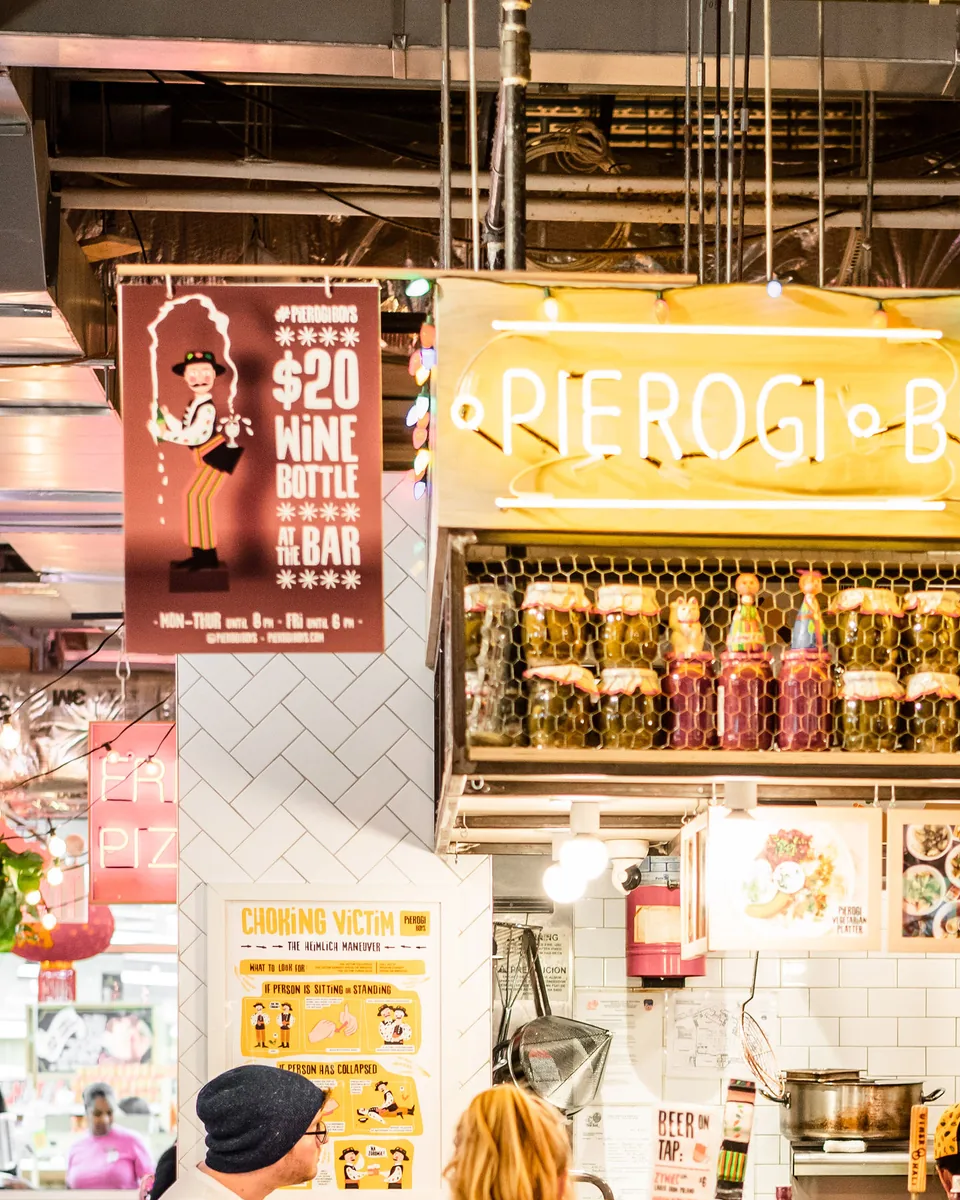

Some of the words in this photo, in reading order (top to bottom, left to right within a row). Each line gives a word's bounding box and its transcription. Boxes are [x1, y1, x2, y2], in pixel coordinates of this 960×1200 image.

[272, 348, 360, 411] $20
[502, 367, 825, 463] PIEROGI
[276, 464, 359, 500] BOTTLE
[276, 547, 300, 567] THE
[302, 525, 360, 566] BAR
[278, 527, 295, 548] AT
[288, 941, 300, 951] THE
[342, 941, 381, 952] MANEUVER
[249, 963, 265, 972] WHAT
[267, 963, 275, 972] TO
[278, 963, 293, 972] LOOK
[264, 983, 271, 994] IF
[273, 984, 300, 995] PERSON
[303, 984, 311, 994] IS
[287, 1064, 317, 1075] PERSON
[319, 1064, 335, 1075] HAS
[337, 1064, 378, 1075] COLLAPSED
[658, 1109, 694, 1139] BEER
[698, 1114, 710, 1130] ON
[658, 1139, 683, 1162] TAP:
